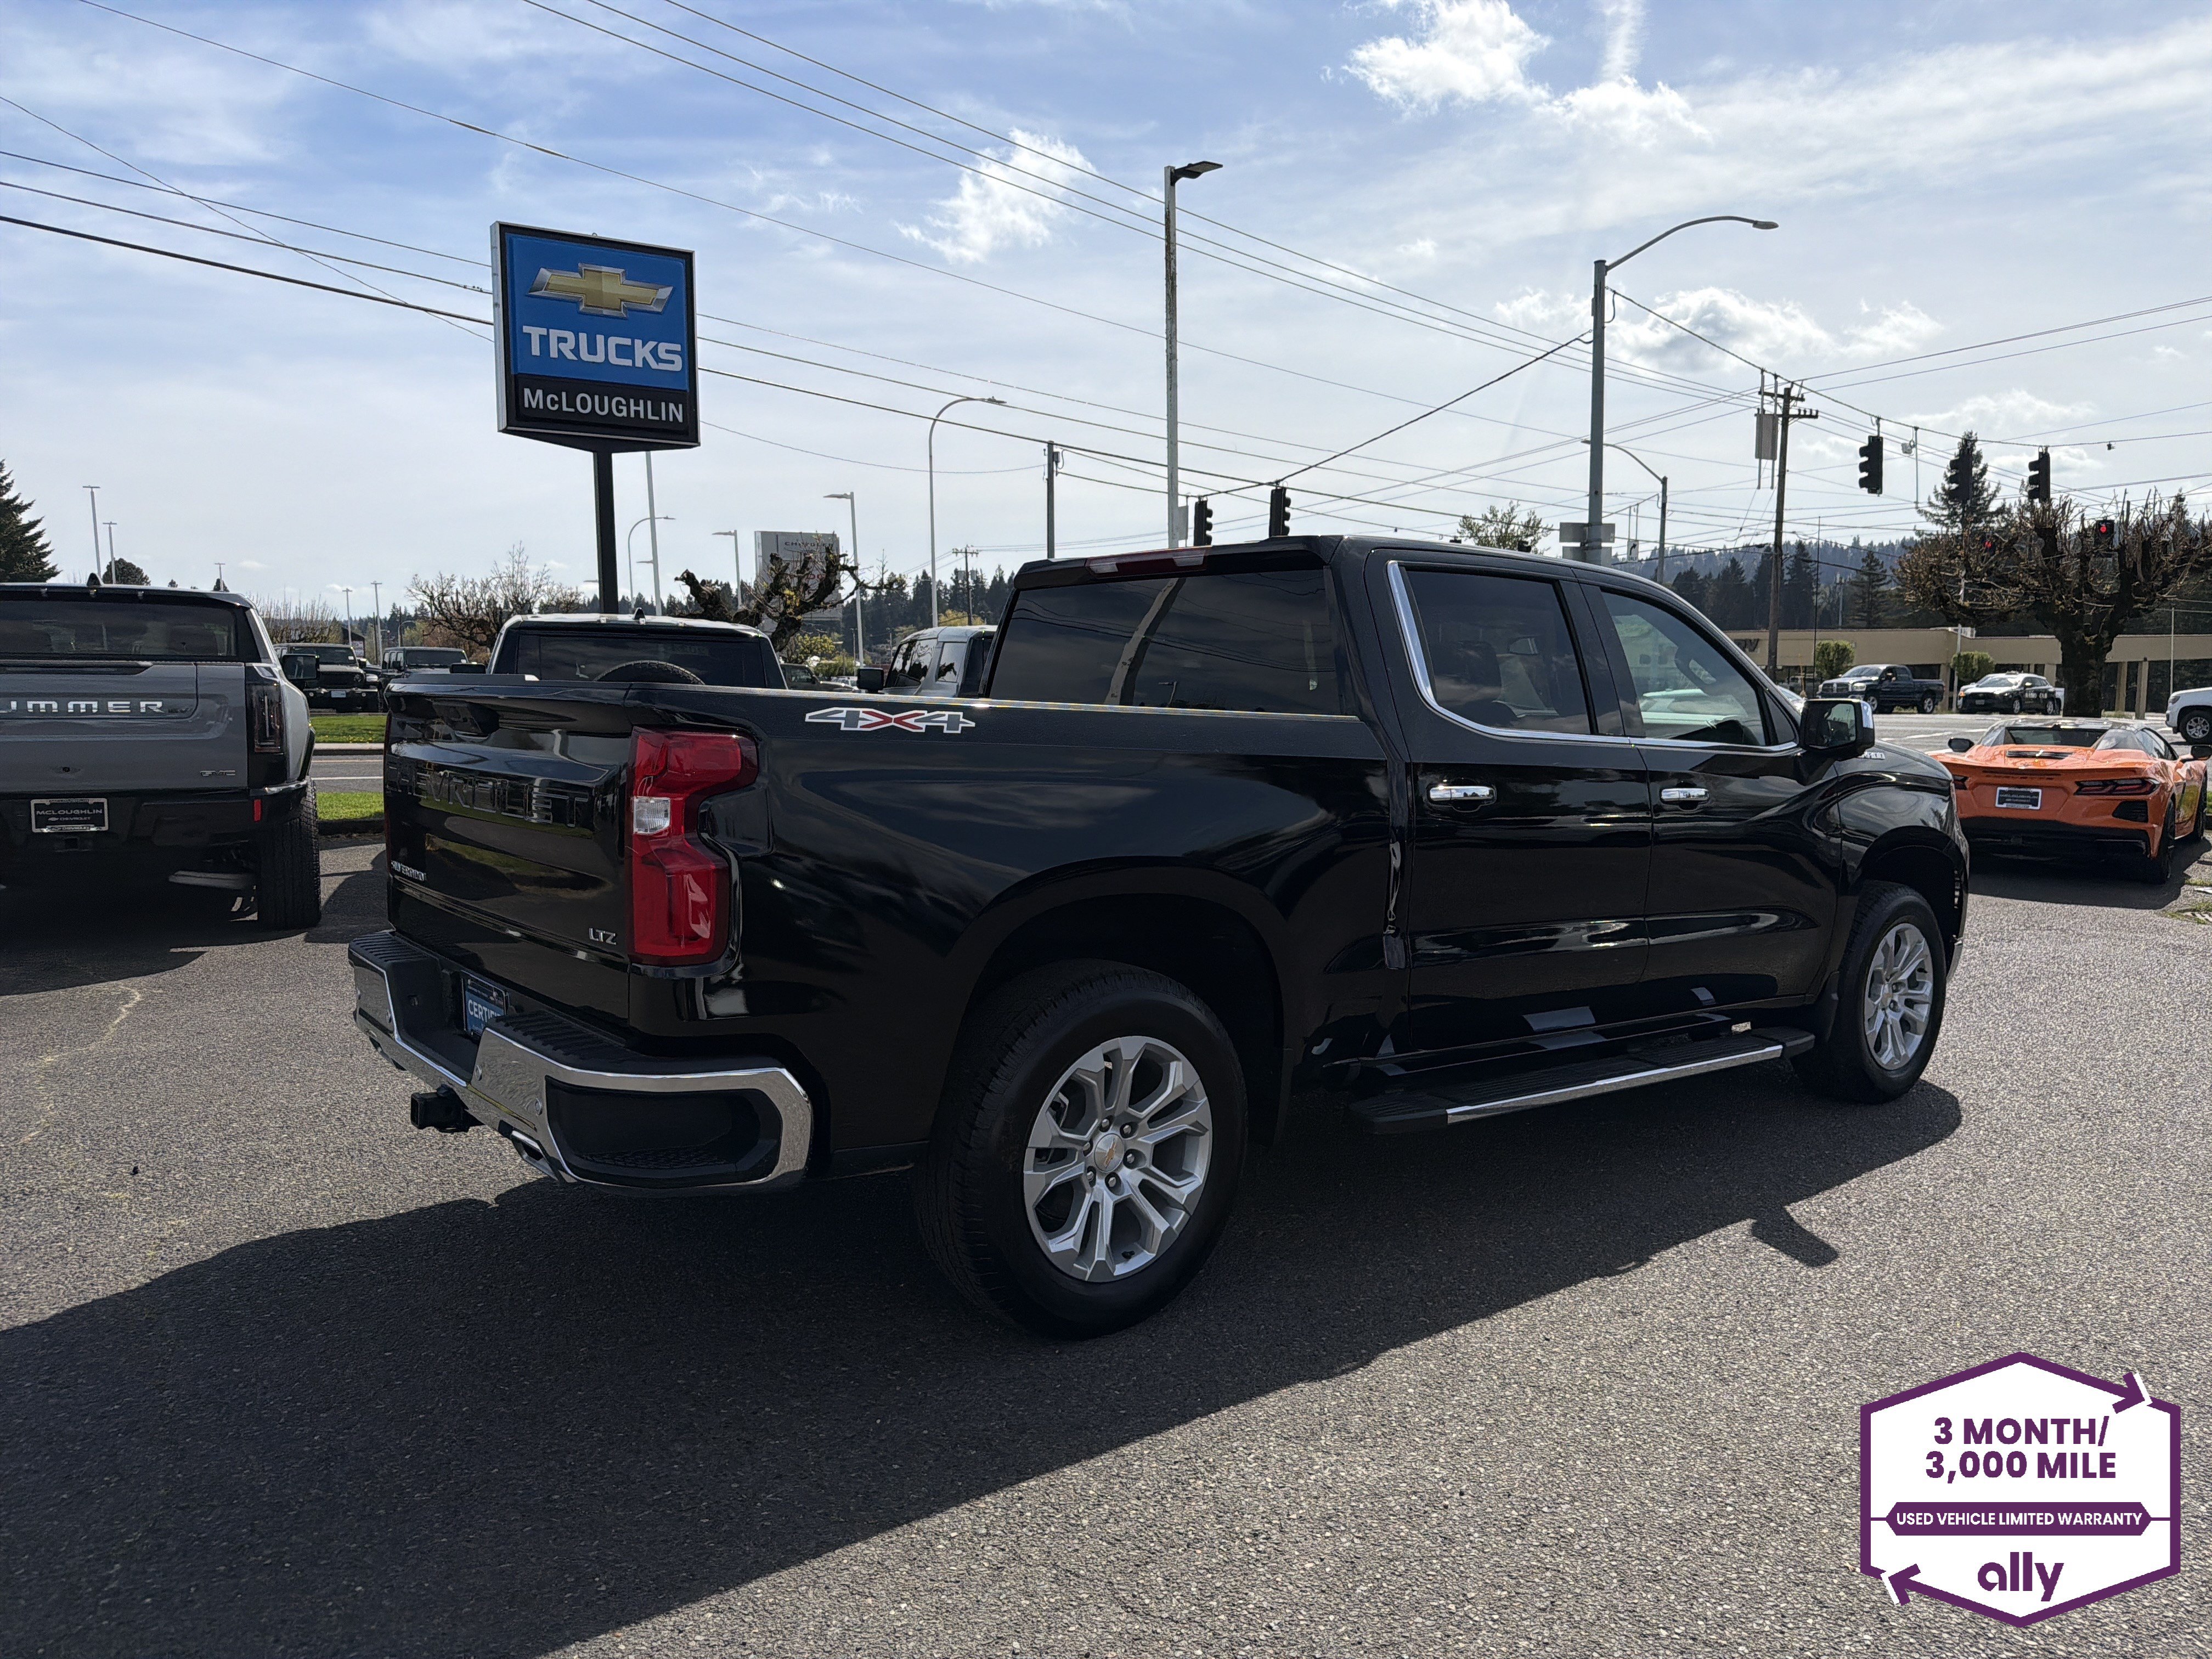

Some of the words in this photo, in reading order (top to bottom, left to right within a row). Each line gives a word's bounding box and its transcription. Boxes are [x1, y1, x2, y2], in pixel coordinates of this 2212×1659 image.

[522, 325, 682, 371] TRUCKS
[523, 388, 683, 422] McLOUGHLIN
[589, 928, 617, 945] LTZ
